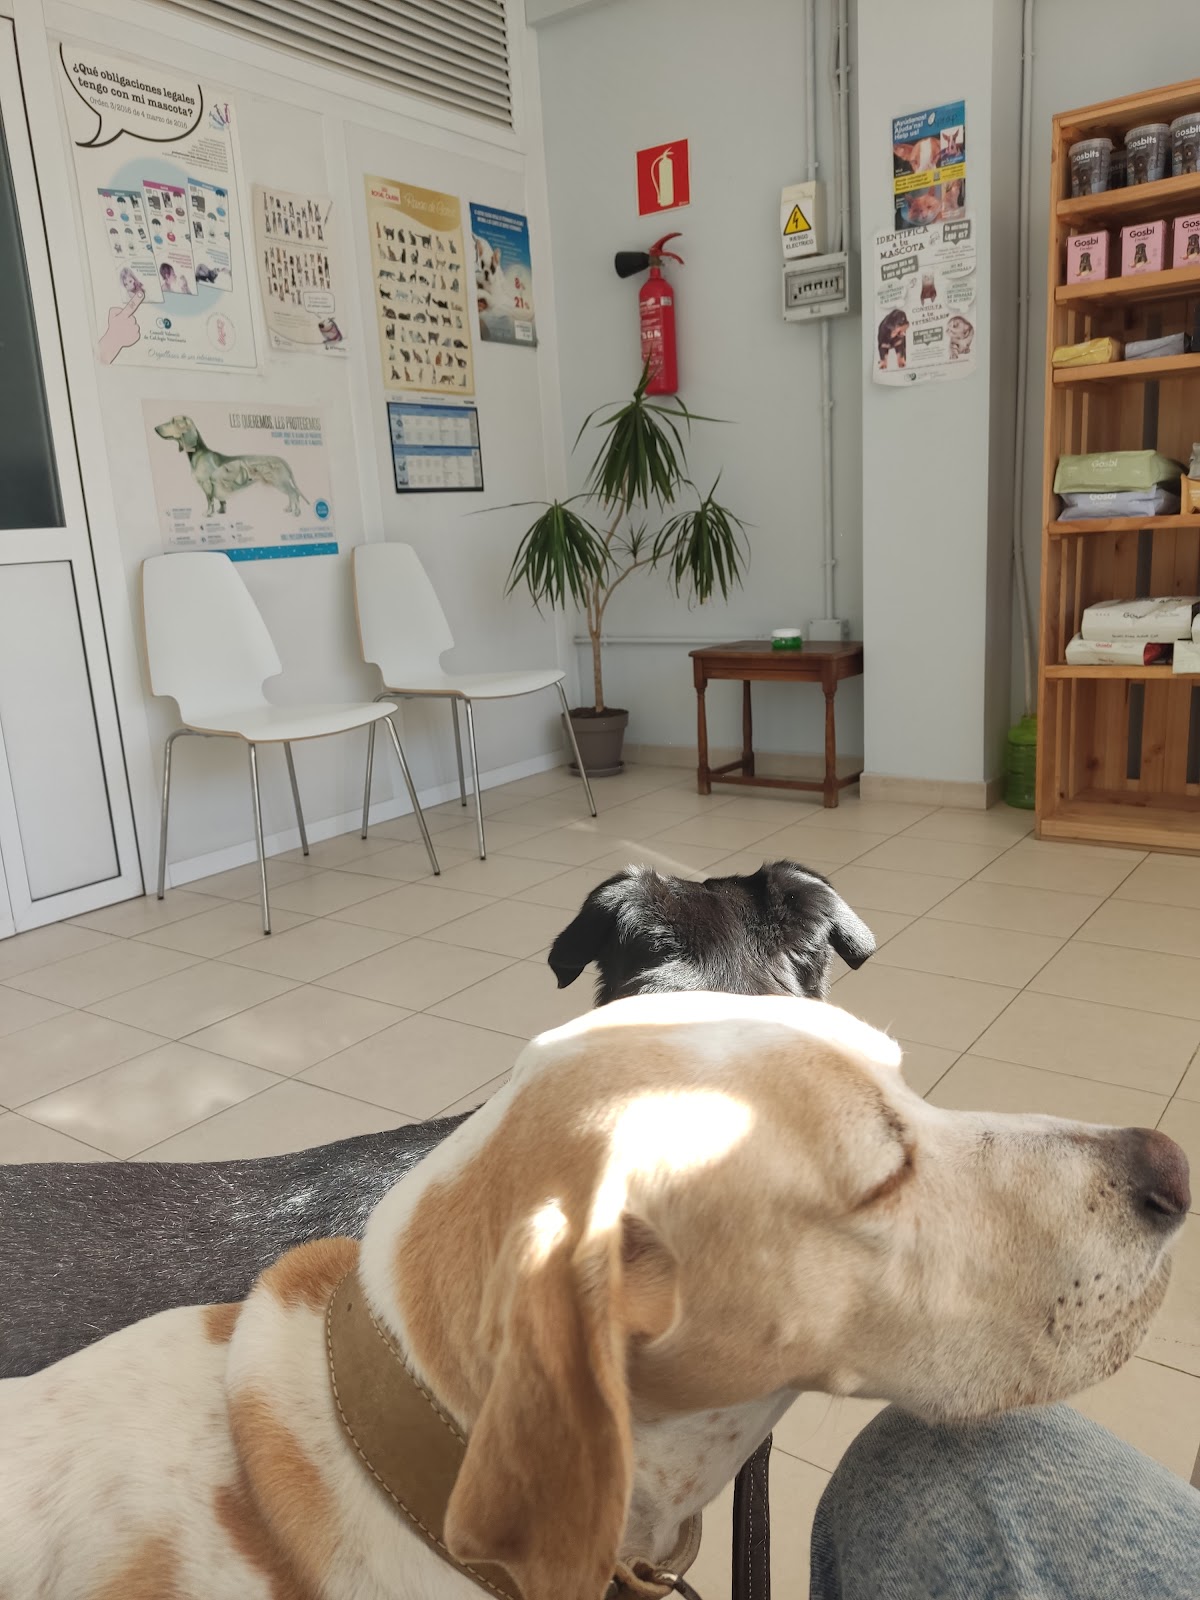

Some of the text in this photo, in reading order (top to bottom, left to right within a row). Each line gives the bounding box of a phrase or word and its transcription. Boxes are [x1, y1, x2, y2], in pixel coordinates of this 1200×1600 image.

[73, 62, 195, 106] ¿Qué obligaciones legales
[78, 77, 193, 118] tengo con mi mascota?
[132, 109, 141, 117] de
[166, 117, 173, 126] de
[1128, 136, 1157, 150] Gosbits
[1072, 150, 1100, 163] Gosbits
[1182, 220, 1200, 229] Gos
[789, 233, 809, 242] RIESGO
[876, 225, 929, 245] IDENTIFICA
[1129, 226, 1155, 239] Gosbi
[1074, 237, 1099, 248] Gosbi
[880, 242, 925, 260] MASCOTA
[229, 413, 241, 428] LES
[274, 416, 285, 430] LES
